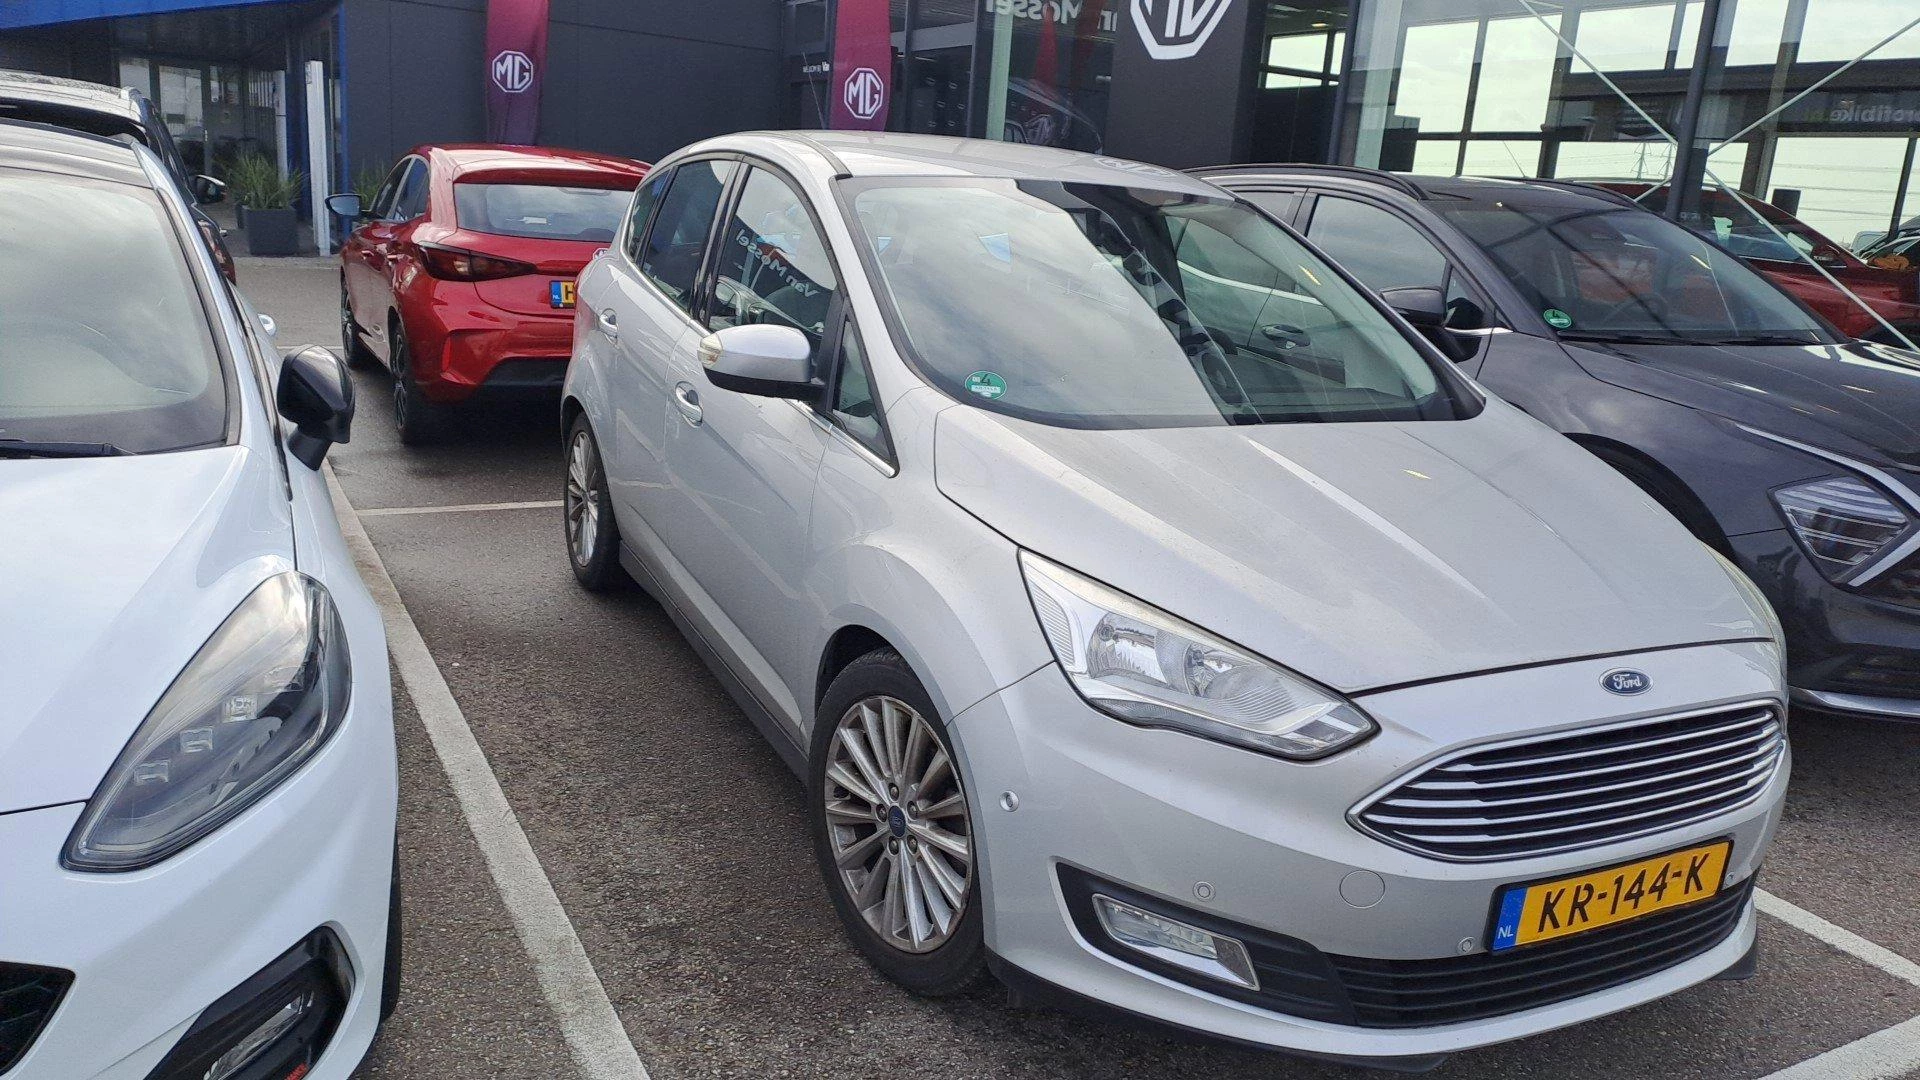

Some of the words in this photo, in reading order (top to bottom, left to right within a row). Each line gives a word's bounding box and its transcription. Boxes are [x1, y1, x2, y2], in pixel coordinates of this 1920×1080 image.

[496, 54, 530, 89] MG
[848, 72, 880, 115] MG
[981, 373, 991, 387] 4
[1612, 673, 1643, 690] Ford
[1497, 926, 1514, 938] NL
[1537, 853, 1710, 933] KR-144-K
